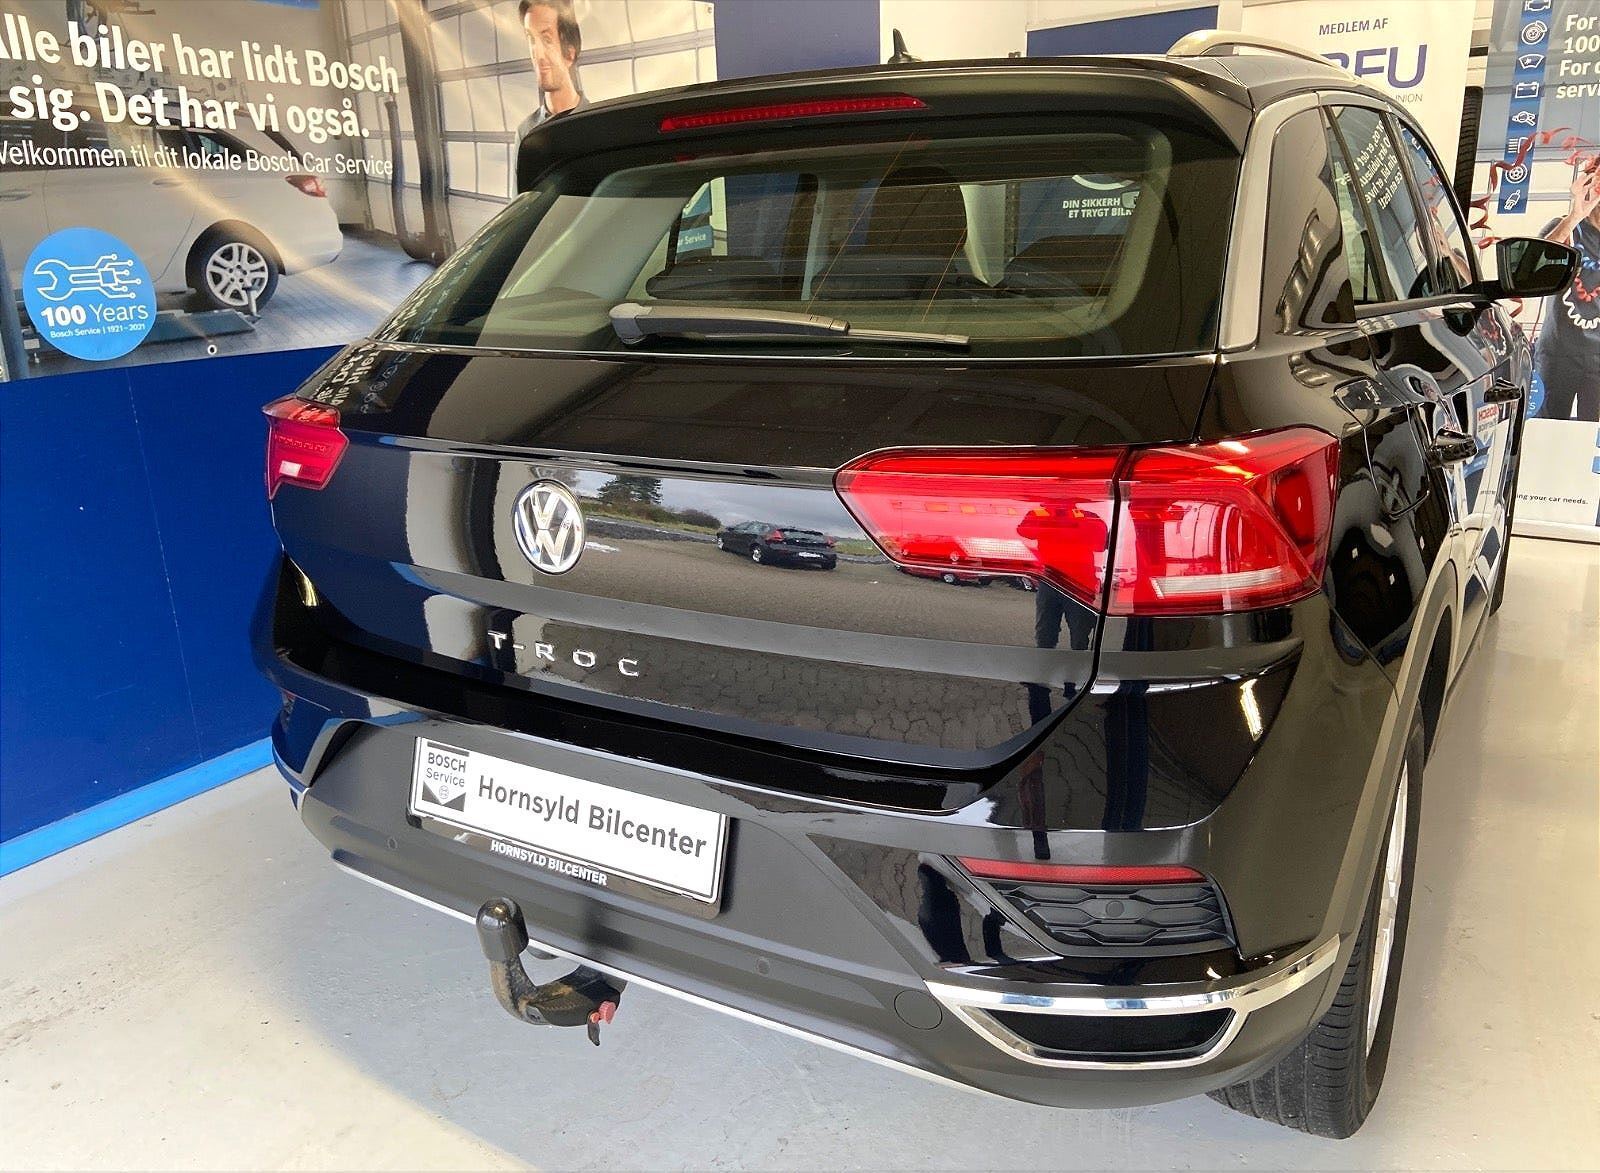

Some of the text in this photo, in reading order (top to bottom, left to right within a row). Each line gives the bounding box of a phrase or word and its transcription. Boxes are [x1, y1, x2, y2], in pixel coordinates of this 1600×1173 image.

[1319, 18, 1389, 35] MEDLEM AF
[1566, 14, 1597, 31] For
[1564, 35, 1600, 54] 100
[67, 21, 165, 72] biler
[172, 33, 234, 79] har
[241, 40, 302, 86] lidt
[304, 49, 400, 94] Bosch
[1560, 60, 1591, 76] For
[9, 74, 370, 144] sig. Det har vi også.
[131, 144, 150, 167] til
[153, 145, 180, 169] dit
[182, 145, 242, 171] lokale
[246, 150, 300, 173] Bosch
[303, 151, 331, 173] Car
[335, 152, 393, 176] Service
[1062, 197, 1120, 209] DIN SIKKERH
[1068, 209, 1079, 219] ET
[1080, 207, 1109, 218] TRYGT
[41, 303, 149, 327] 100 Years
[50, 329, 73, 339] Bosch
[75, 327, 100, 337] Service
[427, 752, 466, 773] BOSCH
[426, 767, 465, 788] Service
[478, 774, 707, 858] Hornsyld Bilcenter
[490, 839, 608, 886] HORNSYLD BILCENTER
